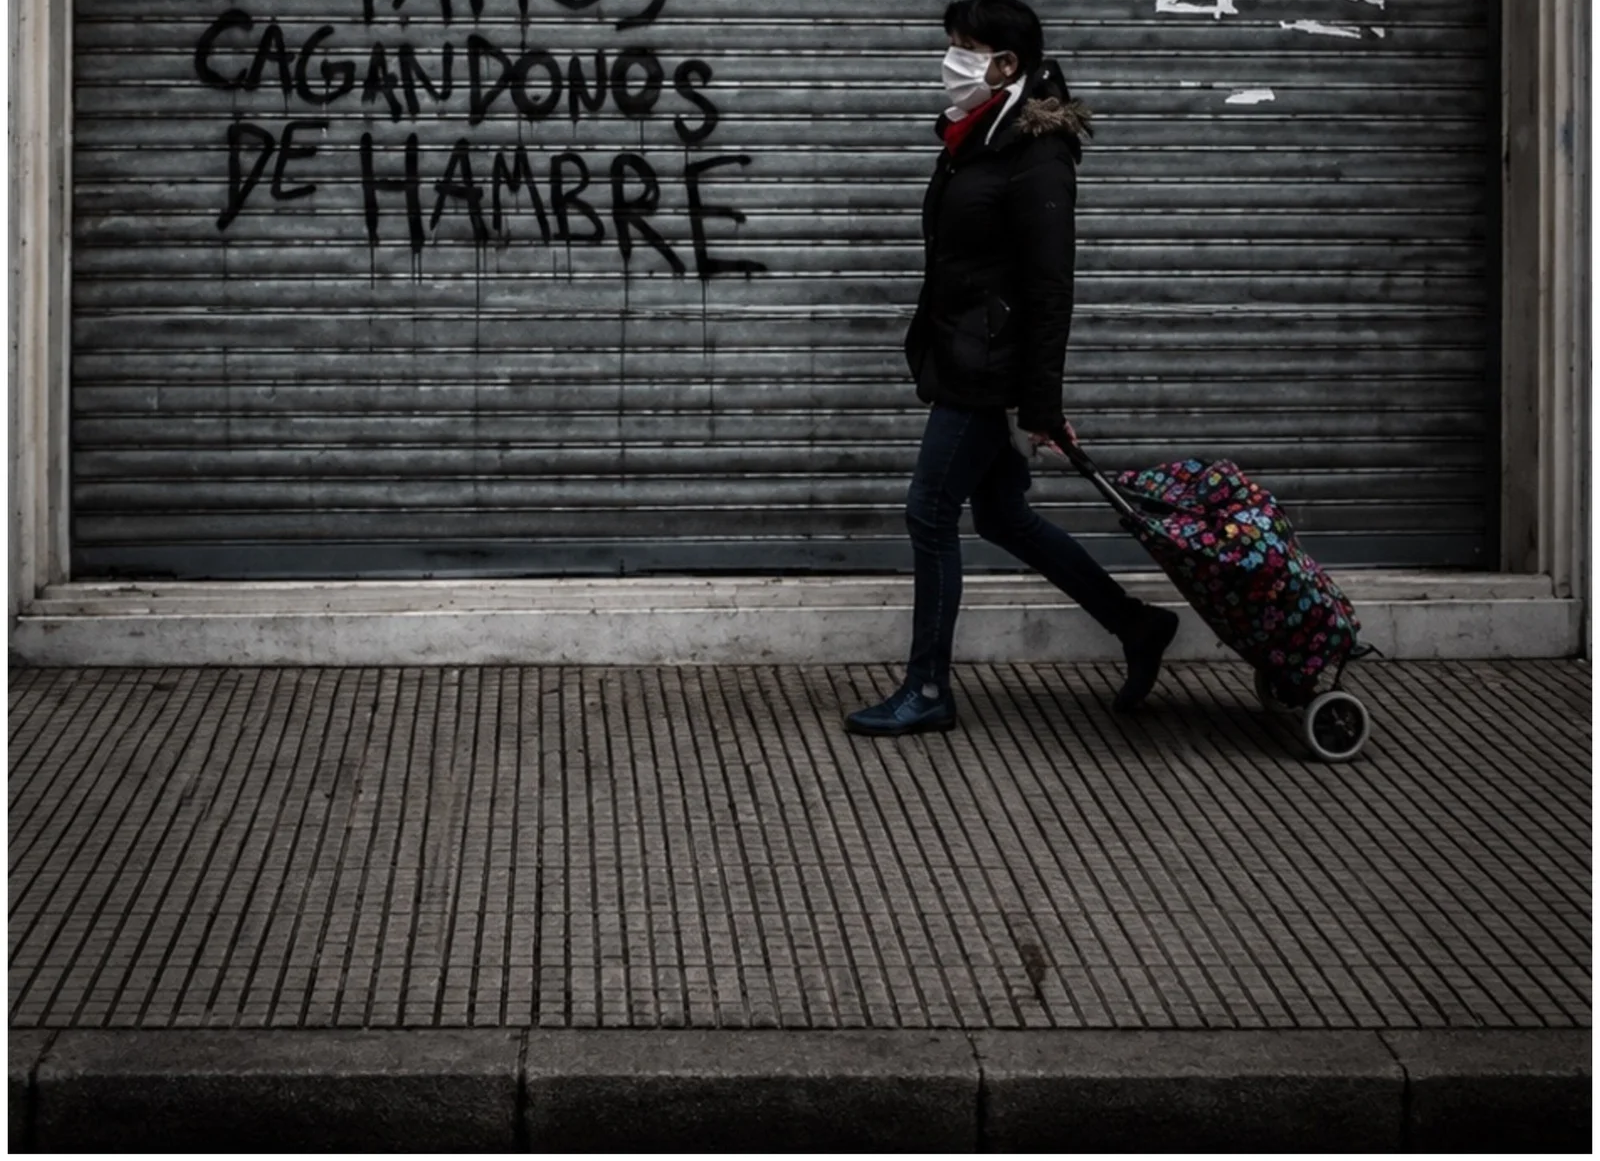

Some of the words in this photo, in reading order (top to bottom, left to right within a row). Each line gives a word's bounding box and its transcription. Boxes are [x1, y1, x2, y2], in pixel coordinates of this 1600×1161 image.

[196, 9, 718, 141] CAGANDONOS
[217, 123, 328, 230] DE
[361, 133, 767, 278] HAMBRE
